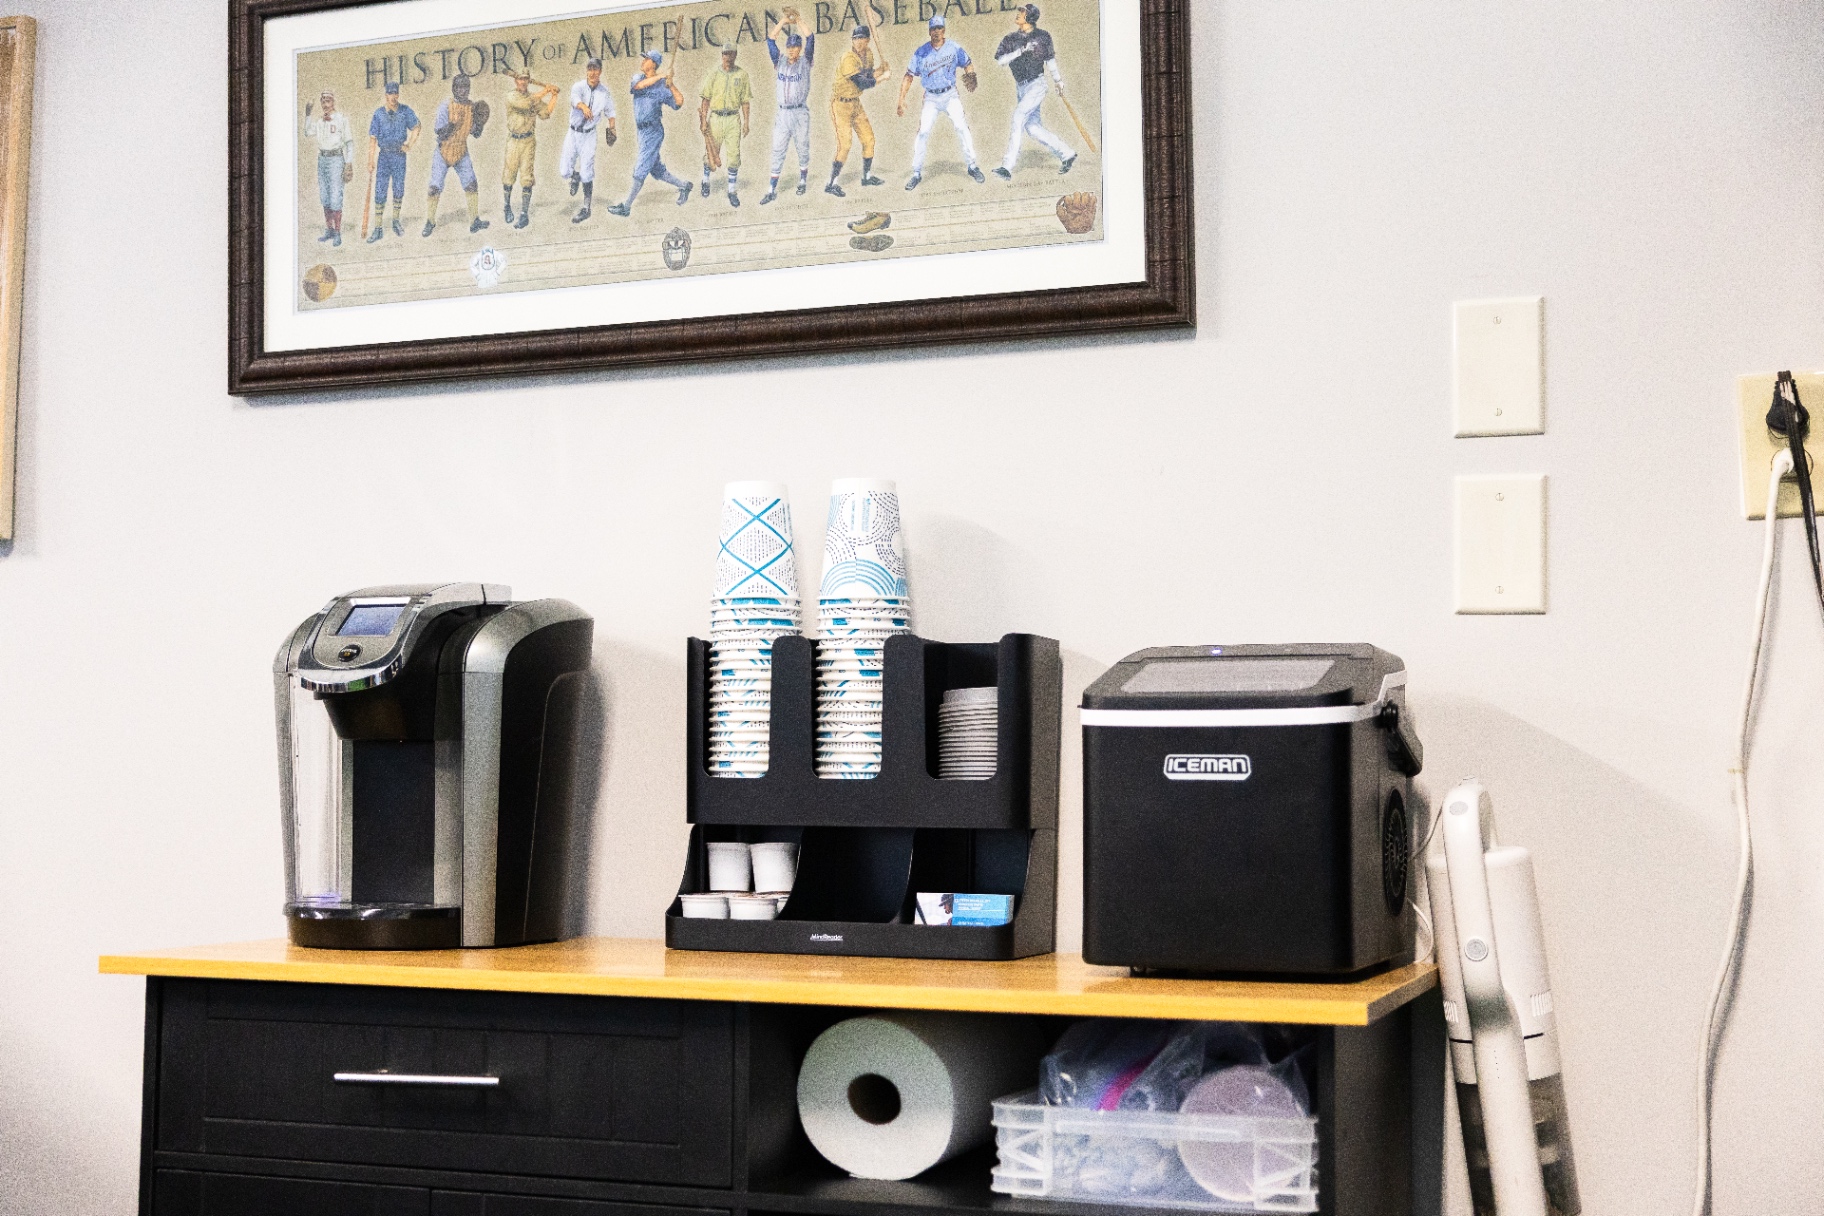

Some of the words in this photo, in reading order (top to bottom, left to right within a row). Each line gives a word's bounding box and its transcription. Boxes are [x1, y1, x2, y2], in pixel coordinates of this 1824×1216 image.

[364, 38, 538, 89] HISTORY
[542, 43, 567, 61] OF
[572, 9, 792, 65] AMERICAN
[1167, 758, 1247, 773] ICEMAN
